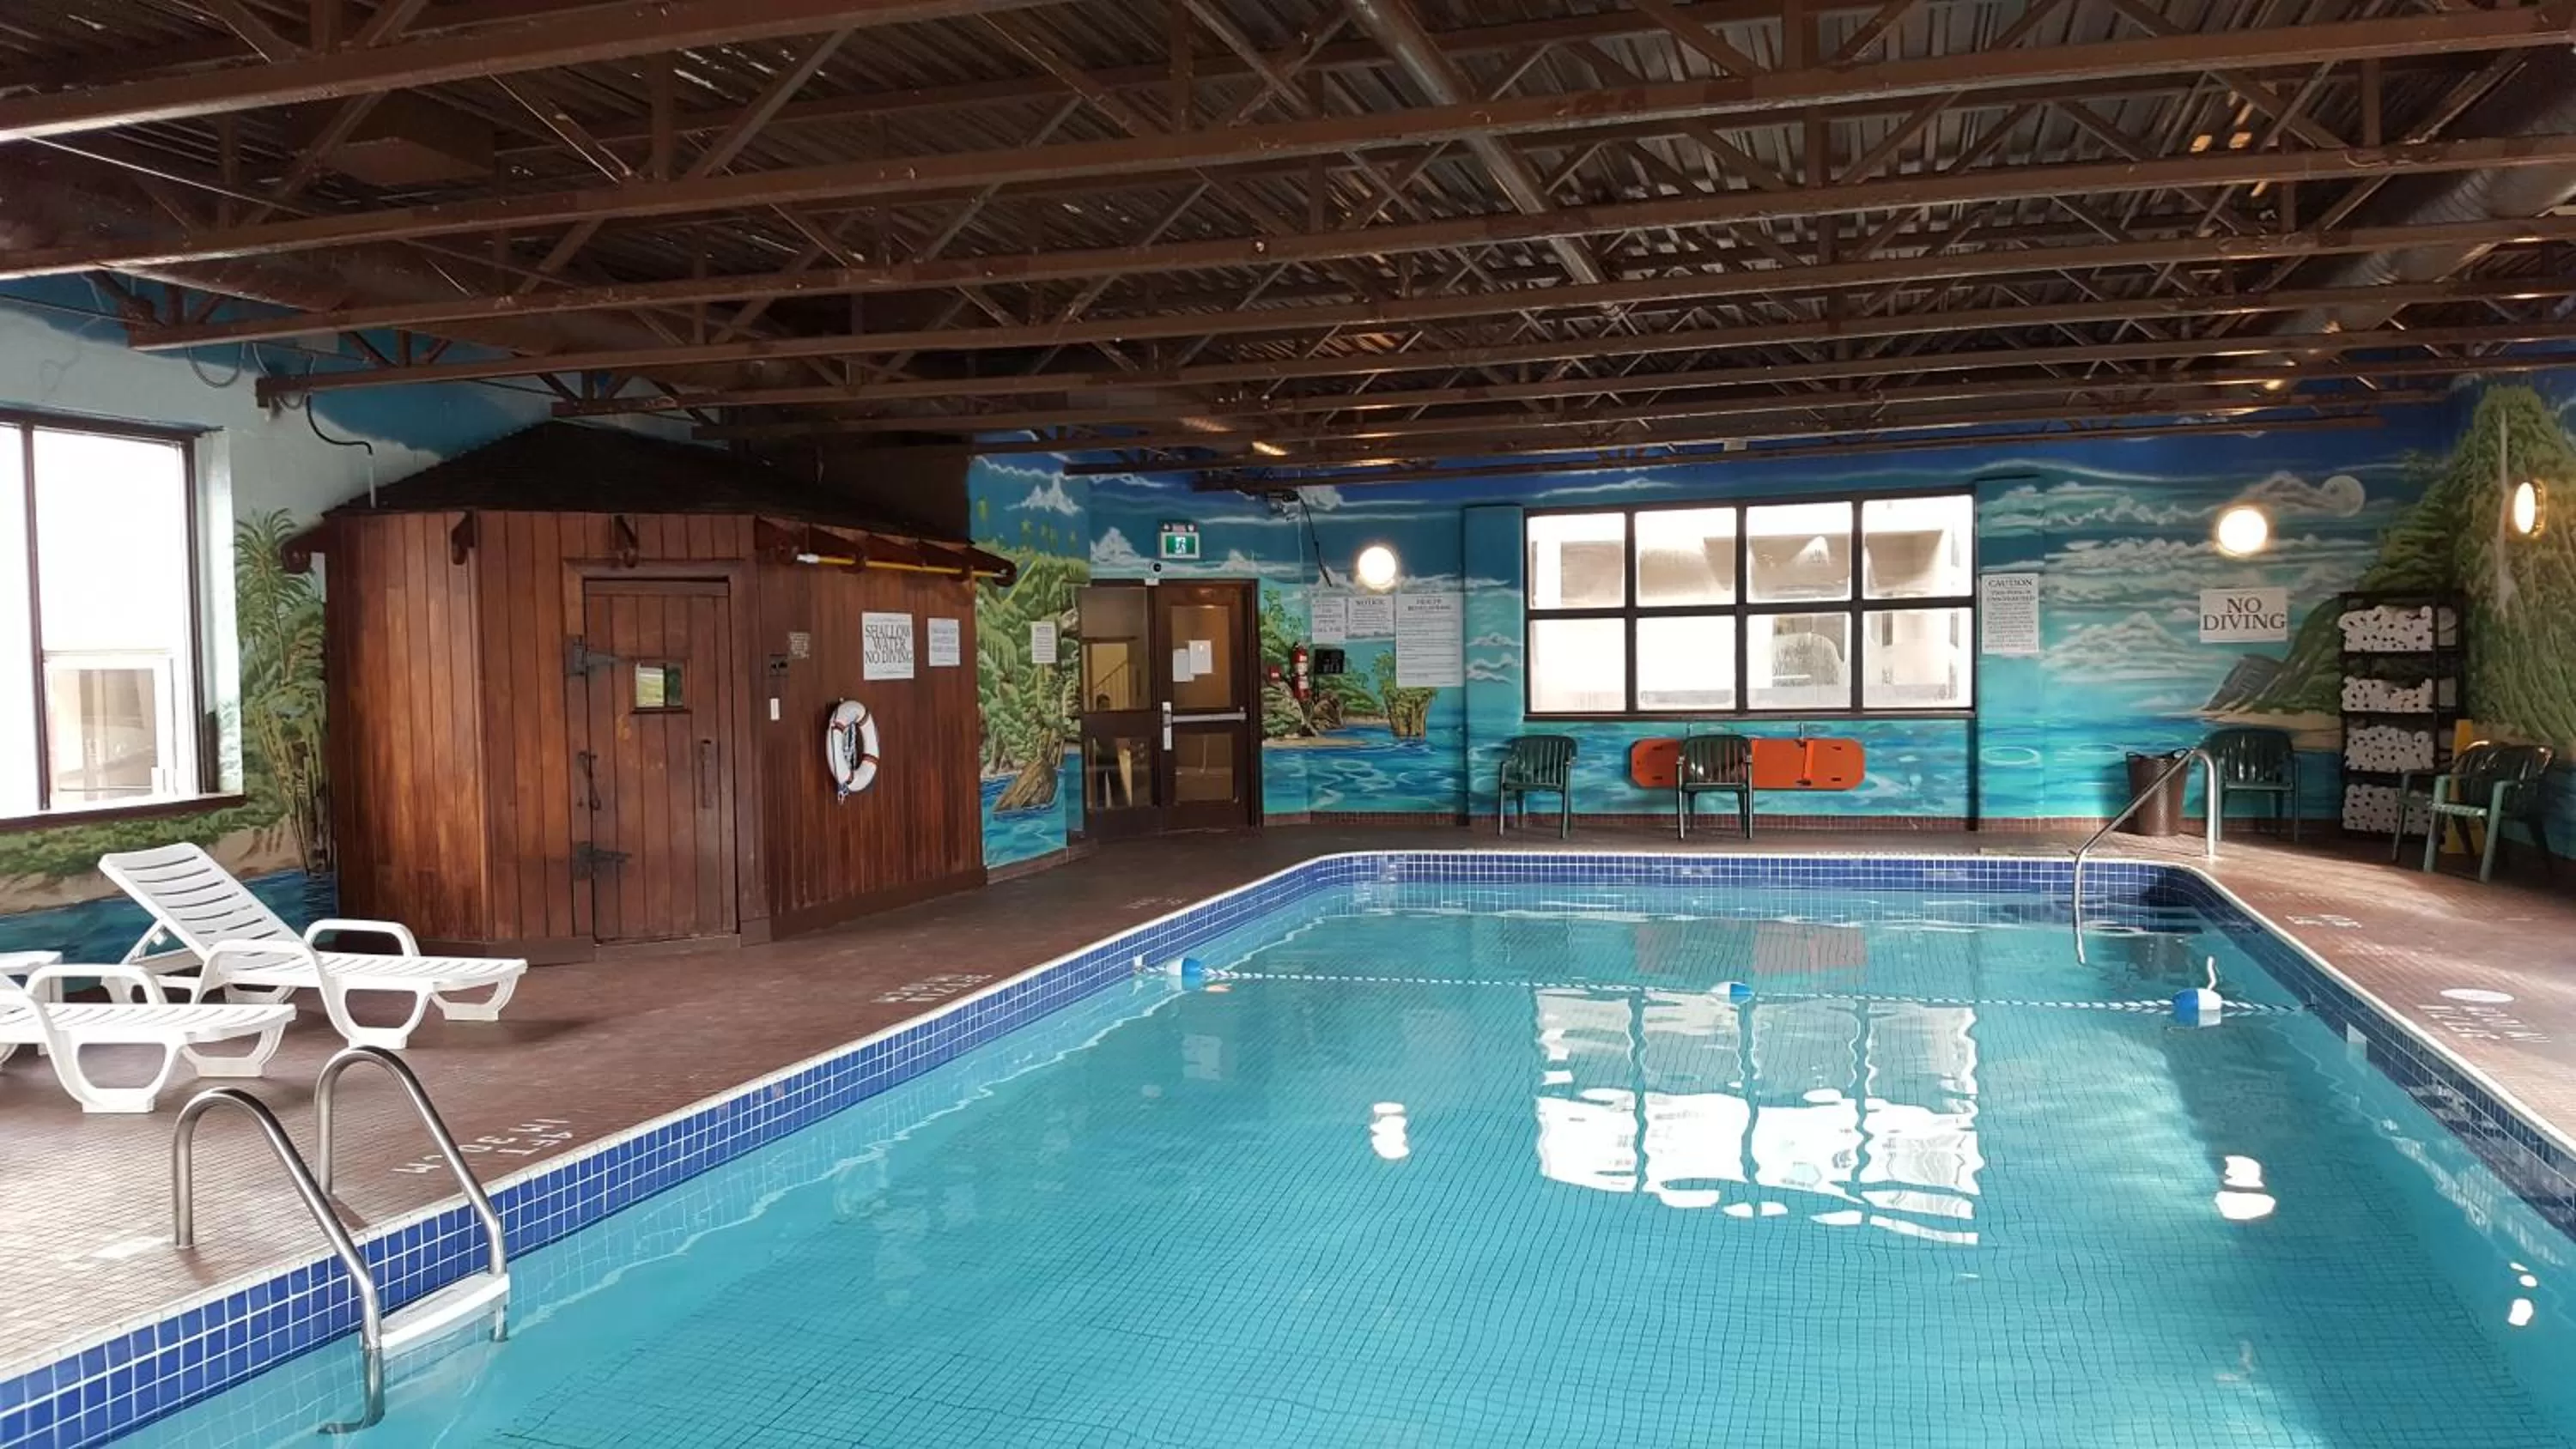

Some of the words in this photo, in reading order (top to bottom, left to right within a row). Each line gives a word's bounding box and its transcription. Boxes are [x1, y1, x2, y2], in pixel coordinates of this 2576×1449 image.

[2226, 597, 2263, 614] NO
[2202, 612, 2285, 631] DIVING
[865, 624, 911, 639] SHALLOW
[872, 637, 907, 651] WATER
[865, 651, 880, 664] NO
[881, 651, 914, 664] DIVING
